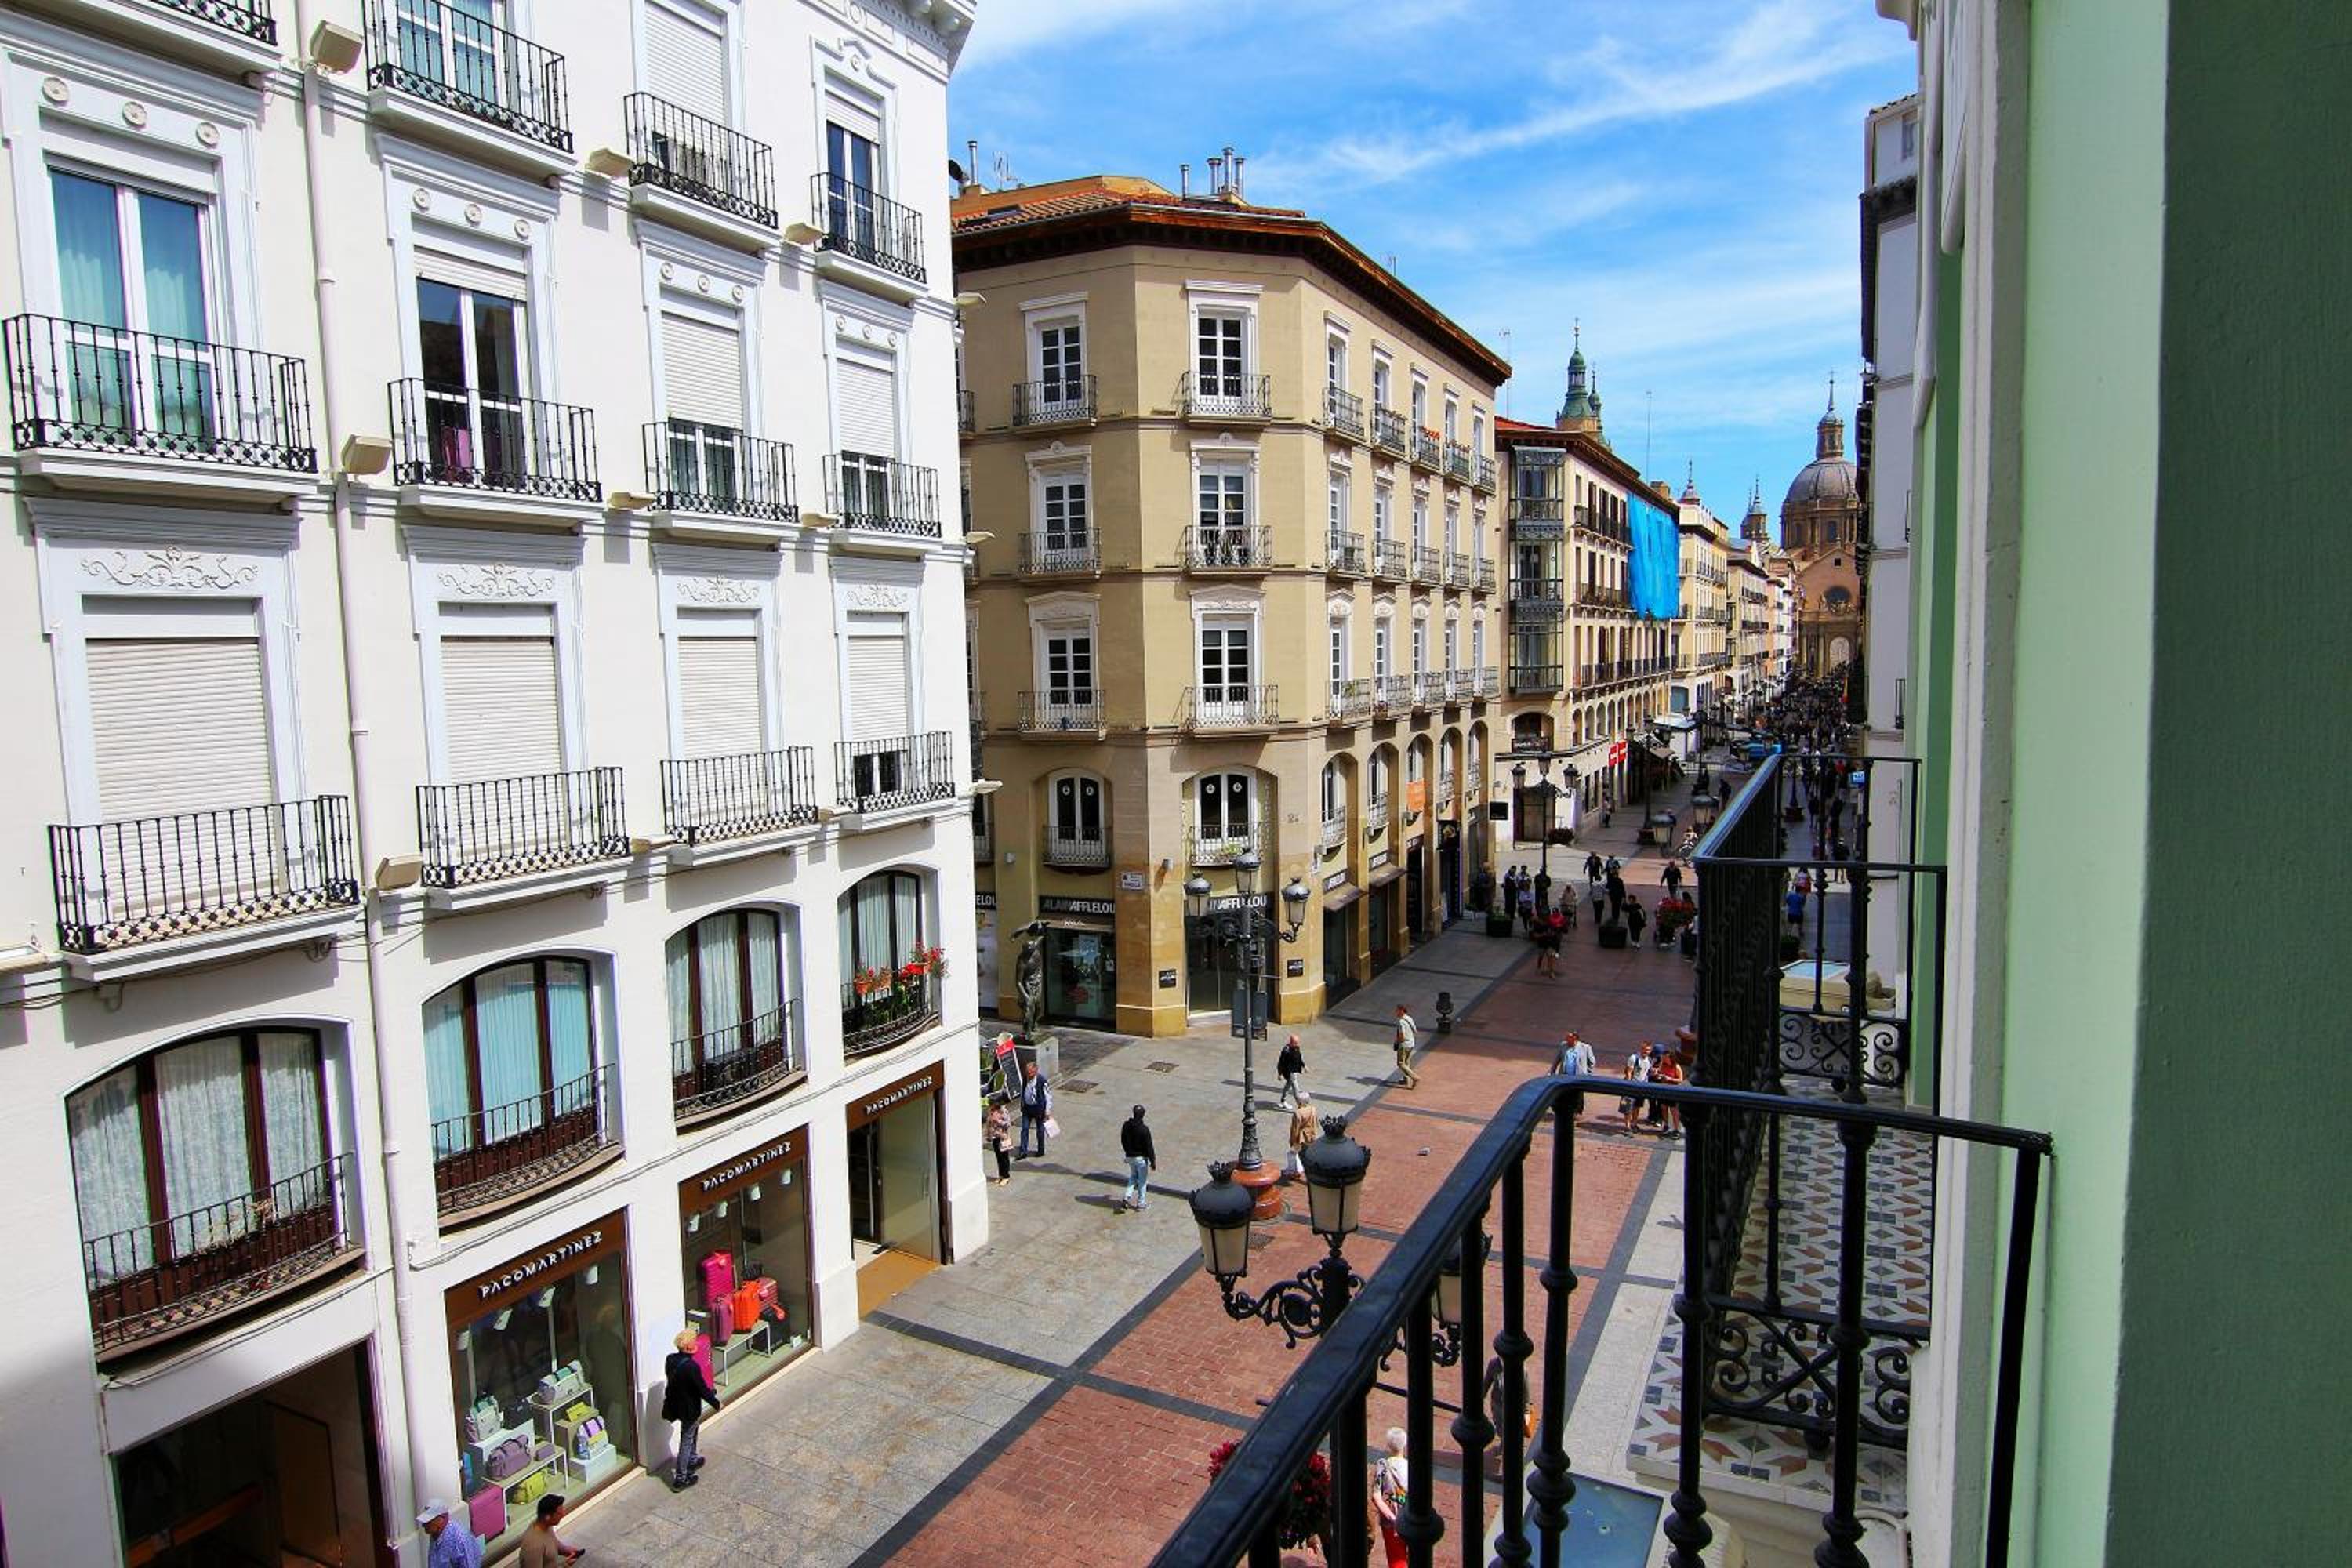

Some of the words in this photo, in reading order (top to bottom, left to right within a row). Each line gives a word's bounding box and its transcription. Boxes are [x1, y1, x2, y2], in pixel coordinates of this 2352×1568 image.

[1069, 900, 1116, 913] AFFLELOU
[865, 1076, 932, 1115] PACOMARTINEZ
[702, 1141, 791, 1191] PACOMARTINEZ
[479, 1230, 603, 1298] PACOMARTINEZ
